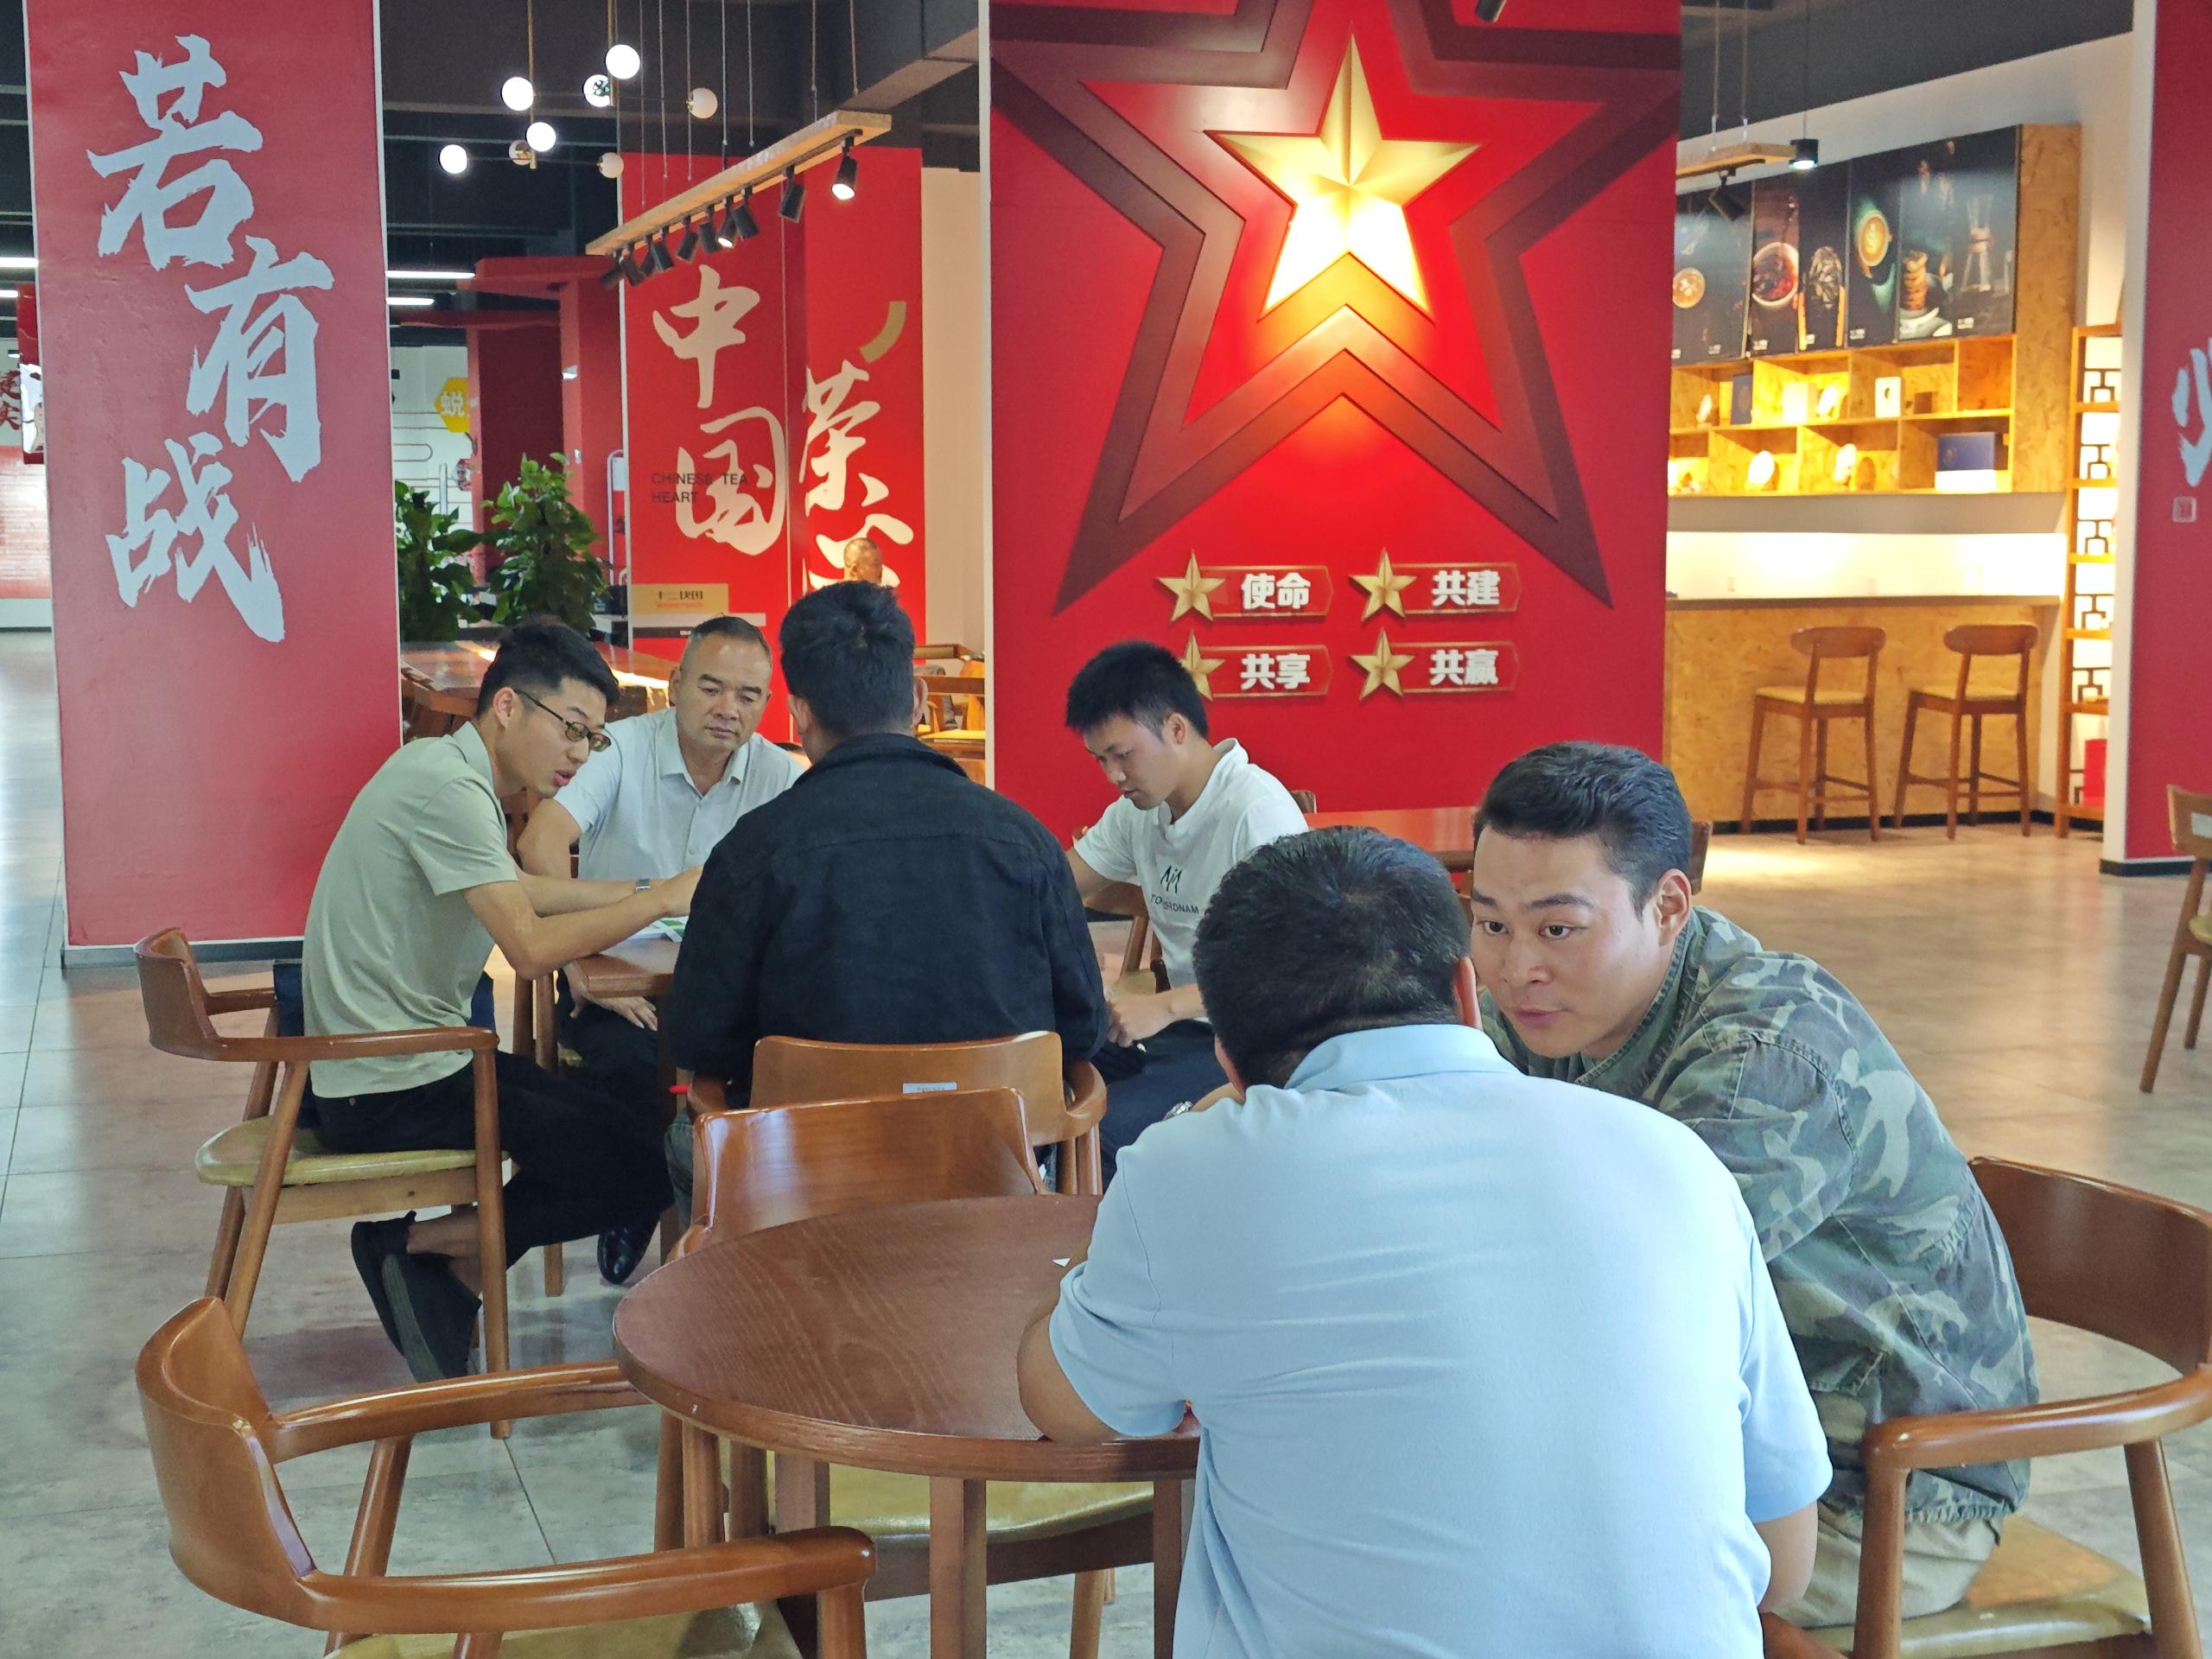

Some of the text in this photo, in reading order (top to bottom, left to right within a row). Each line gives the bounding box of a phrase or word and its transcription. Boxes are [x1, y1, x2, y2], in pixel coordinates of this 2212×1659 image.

[87, 34, 334, 642] 若有战
[652, 264, 785, 556] 中国
[652, 473, 747, 485] CHINESE TEA
[652, 491, 698, 503] HEART
[1241, 572, 1312, 609] 使命
[1431, 570, 1501, 607] 共建
[1240, 653, 1311, 690] 共享
[1429, 649, 1499, 686] 共赢
